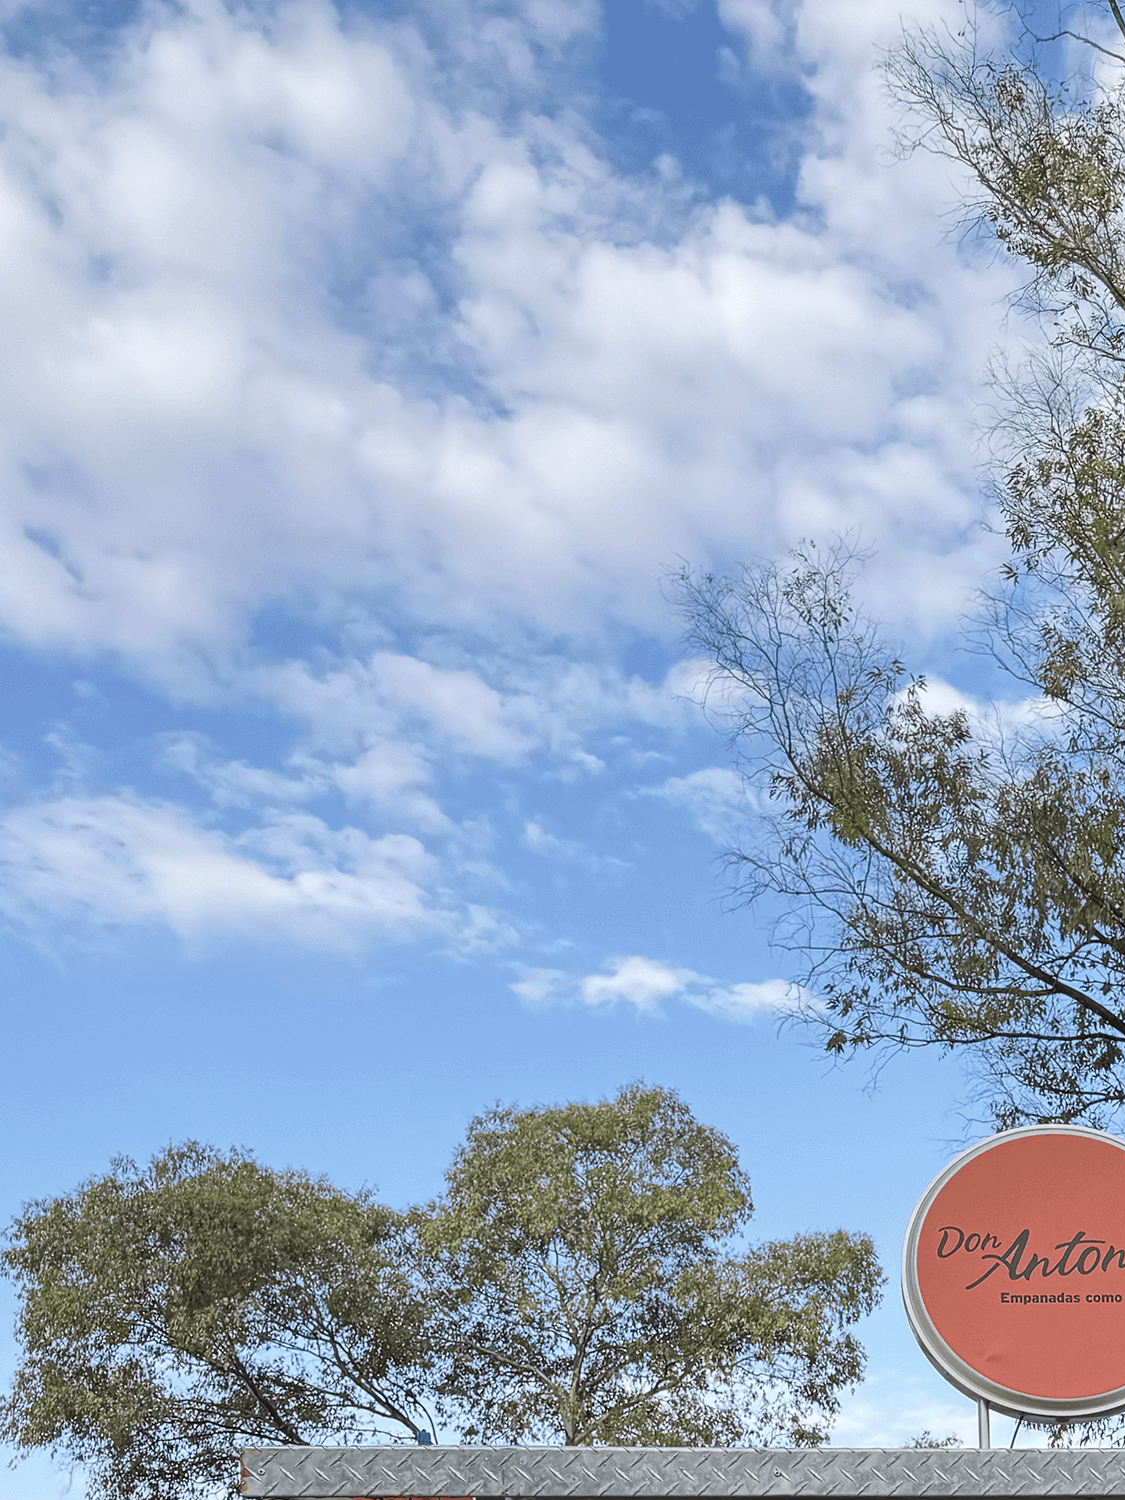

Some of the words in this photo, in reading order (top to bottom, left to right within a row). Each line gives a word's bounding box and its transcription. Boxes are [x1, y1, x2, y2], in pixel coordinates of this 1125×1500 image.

[938, 1226, 1001, 1258] Don
[1000, 1292, 1081, 1306] Empanadas
[1085, 1294, 1123, 1304] como
